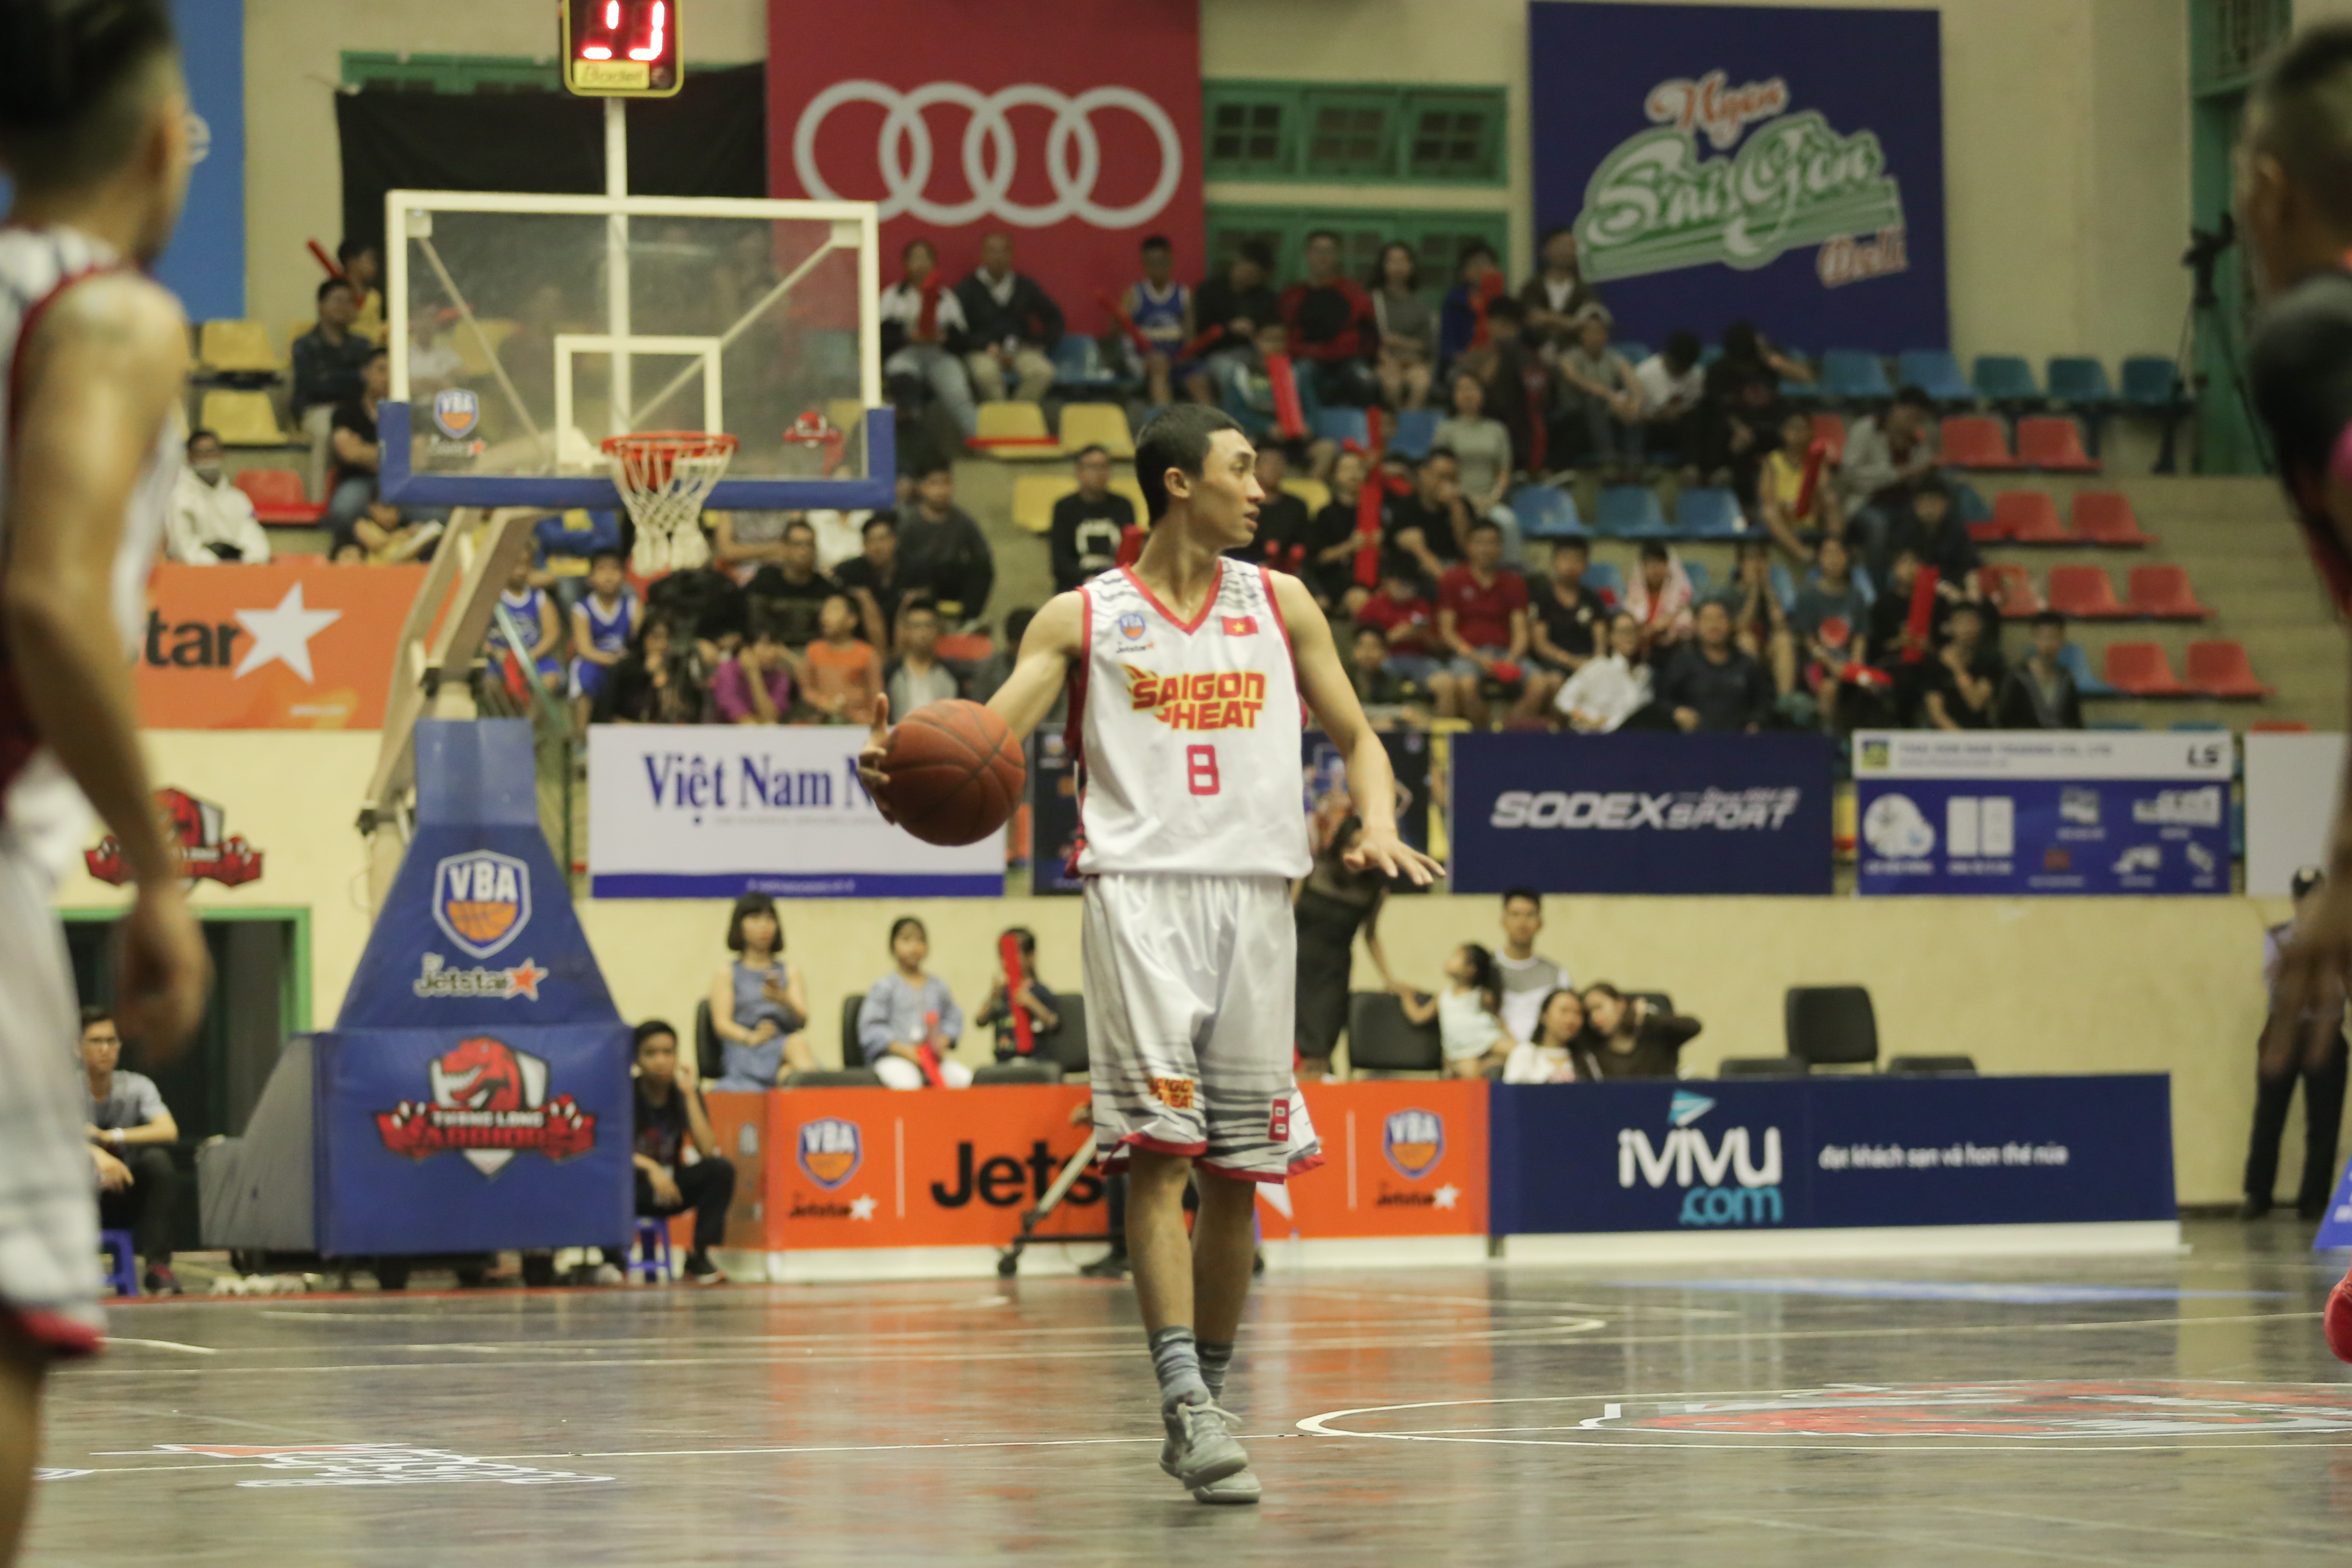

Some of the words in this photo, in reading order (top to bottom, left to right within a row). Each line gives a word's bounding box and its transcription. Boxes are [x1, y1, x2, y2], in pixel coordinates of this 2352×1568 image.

[145, 609, 241, 669] tar
[1132, 671, 1266, 711] SAIGON
[1170, 701, 1263, 730] HEAT
[1187, 744, 1220, 795] 8
[644, 753, 725, 826] Việt
[740, 756, 833, 808] Nam
[1491, 791, 1674, 830] SODEX
[447, 861, 519, 903] VBA
[415, 968, 508, 996] Jetstar
[803, 1121, 856, 1153] VBA
[1268, 1098, 1289, 1141] 8
[1388, 1110, 1439, 1142] VBA
[1679, 1185, 1783, 1224] .com
